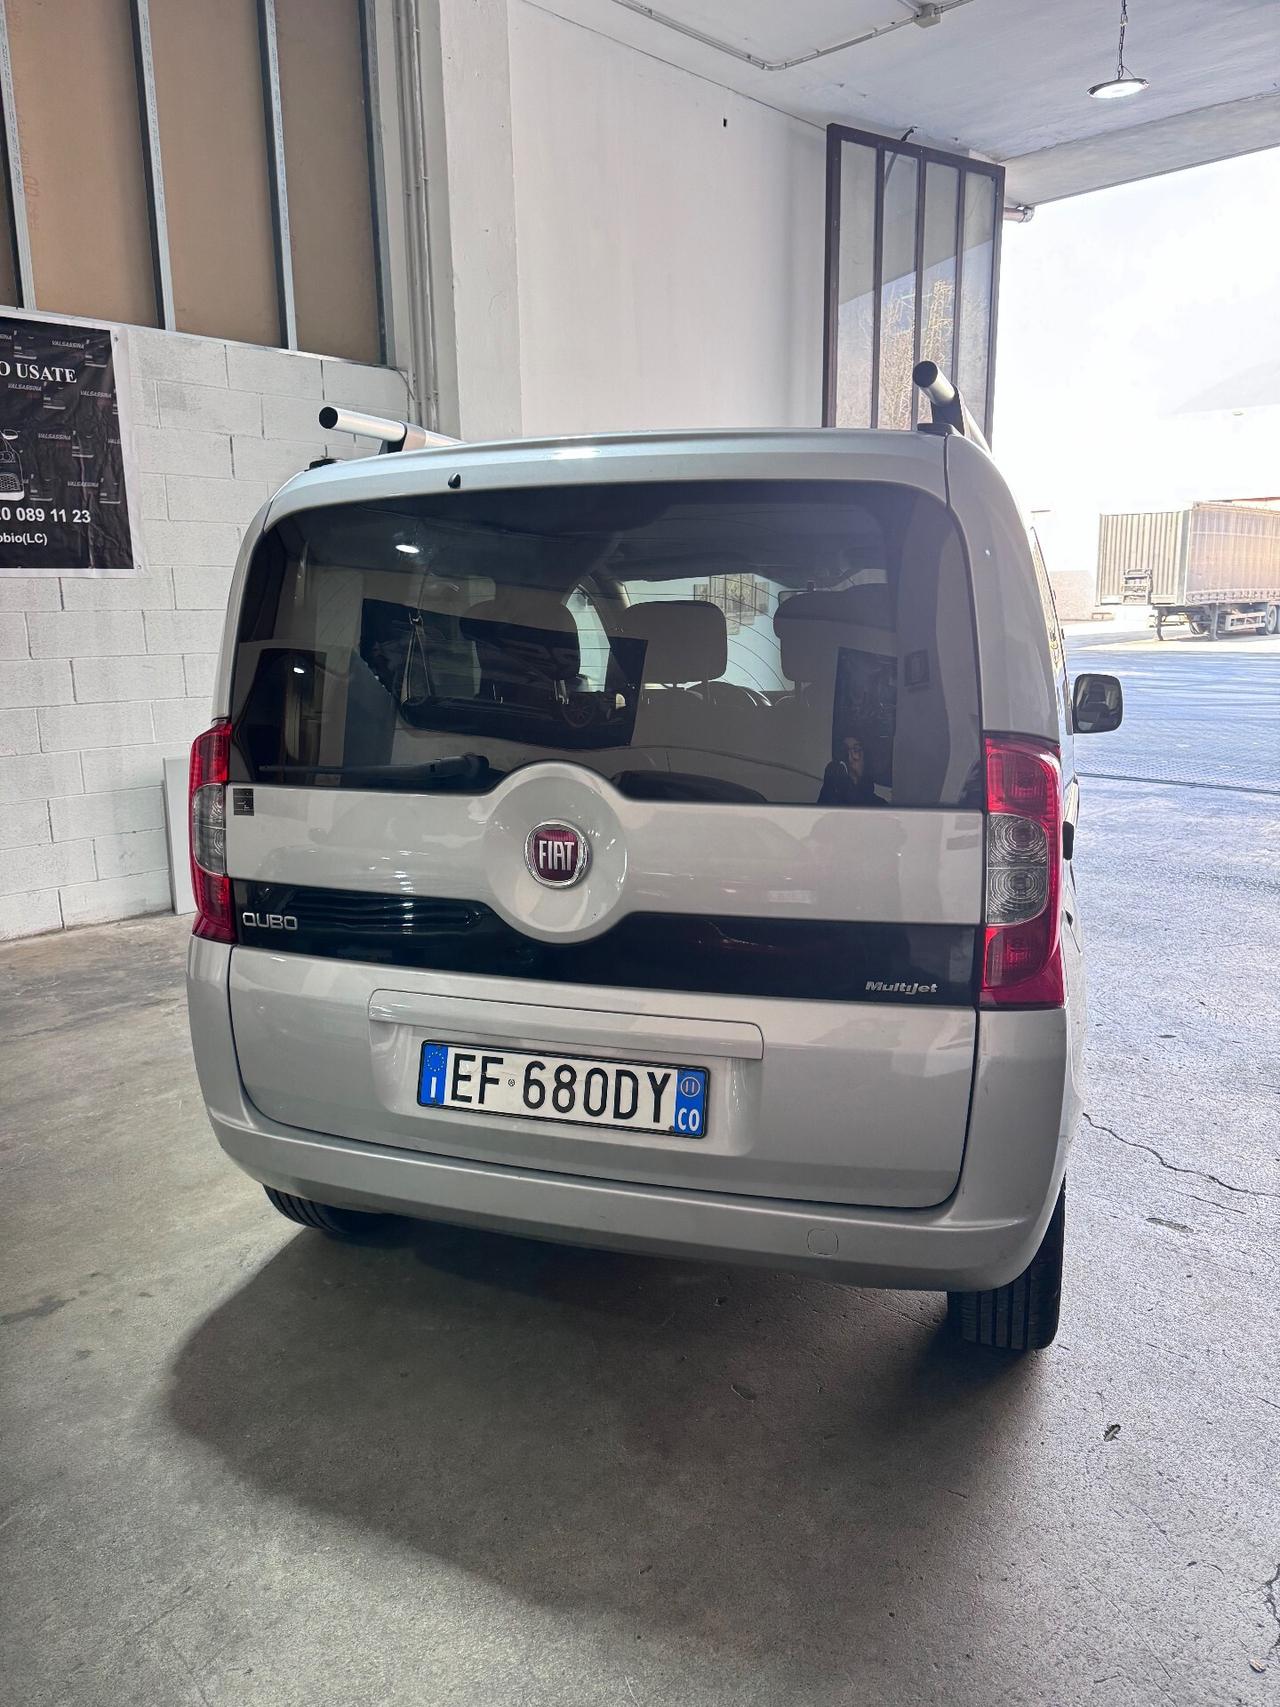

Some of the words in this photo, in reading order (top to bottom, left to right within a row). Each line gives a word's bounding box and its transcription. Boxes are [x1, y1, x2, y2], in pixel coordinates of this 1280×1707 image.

[16, 363, 77, 383] USATE
[0, 507, 11, 521] 0
[16, 508, 45, 521] 089
[50, 509, 67, 522] 11
[72, 510, 91, 523] 23
[539, 839, 575, 871] FIAT
[242, 911, 299, 931] QUBO
[450, 1052, 504, 1105] EF
[522, 1060, 672, 1124] 680DY
[677, 1107, 700, 1132] CO
